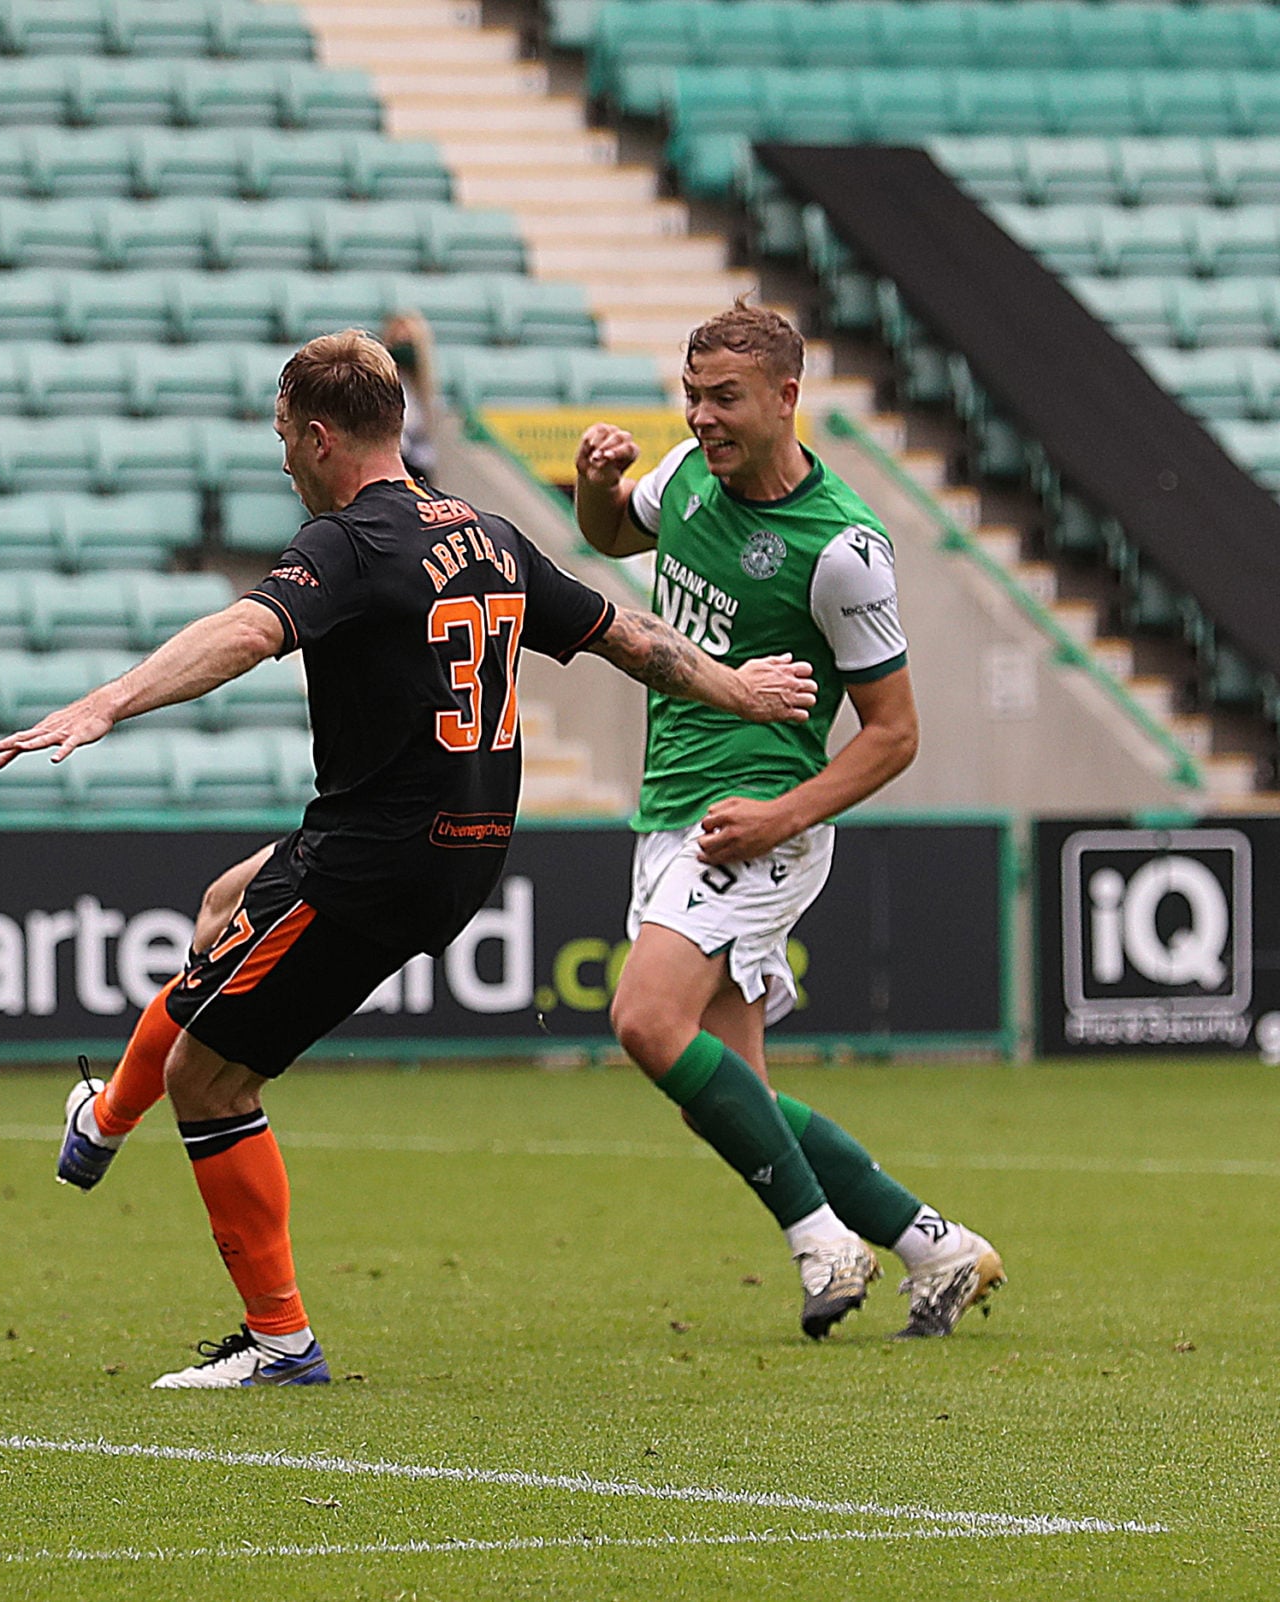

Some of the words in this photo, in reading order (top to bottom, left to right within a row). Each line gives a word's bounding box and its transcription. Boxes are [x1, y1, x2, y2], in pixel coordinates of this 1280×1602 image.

[657, 573, 733, 656] NHS
[661, 553, 707, 598] THANK
[706, 584, 739, 617] YOU
[428, 593, 526, 751] 37
[1088, 854, 1230, 990] iQ
